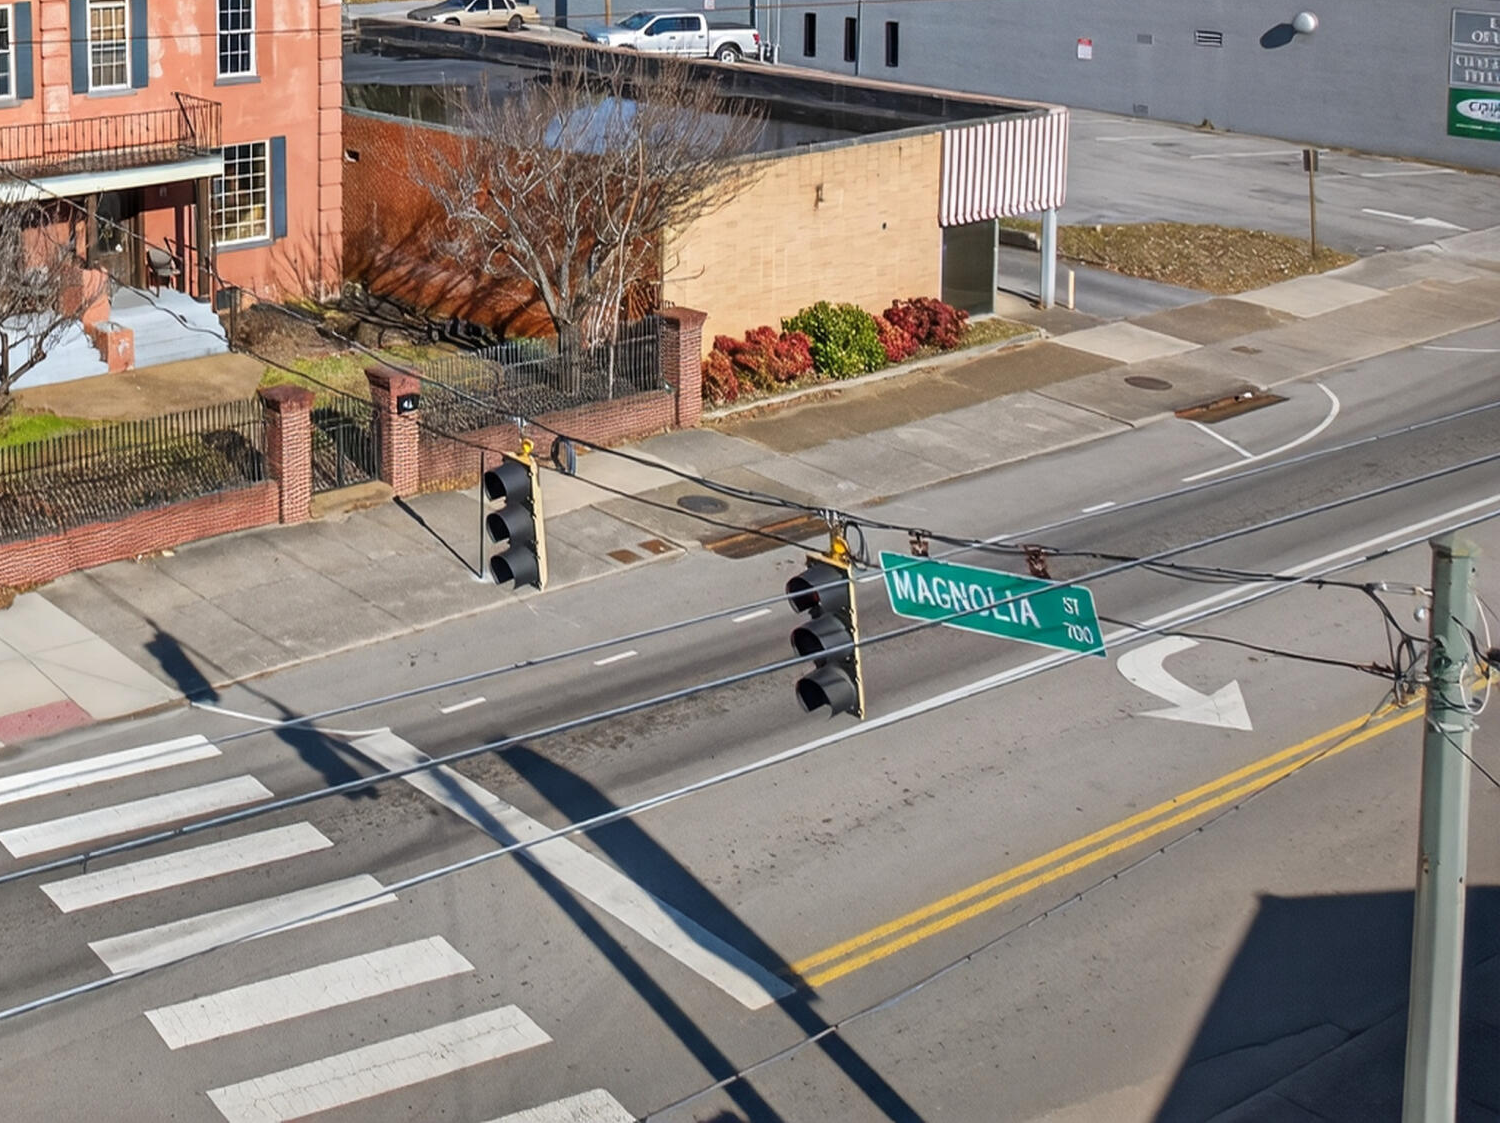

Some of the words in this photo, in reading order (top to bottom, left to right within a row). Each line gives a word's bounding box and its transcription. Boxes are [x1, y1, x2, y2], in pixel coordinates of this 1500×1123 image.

[891, 570, 1041, 628] MAGNOLIA
[1062, 596, 1080, 616] ST
[1062, 621, 1094, 645] 700
